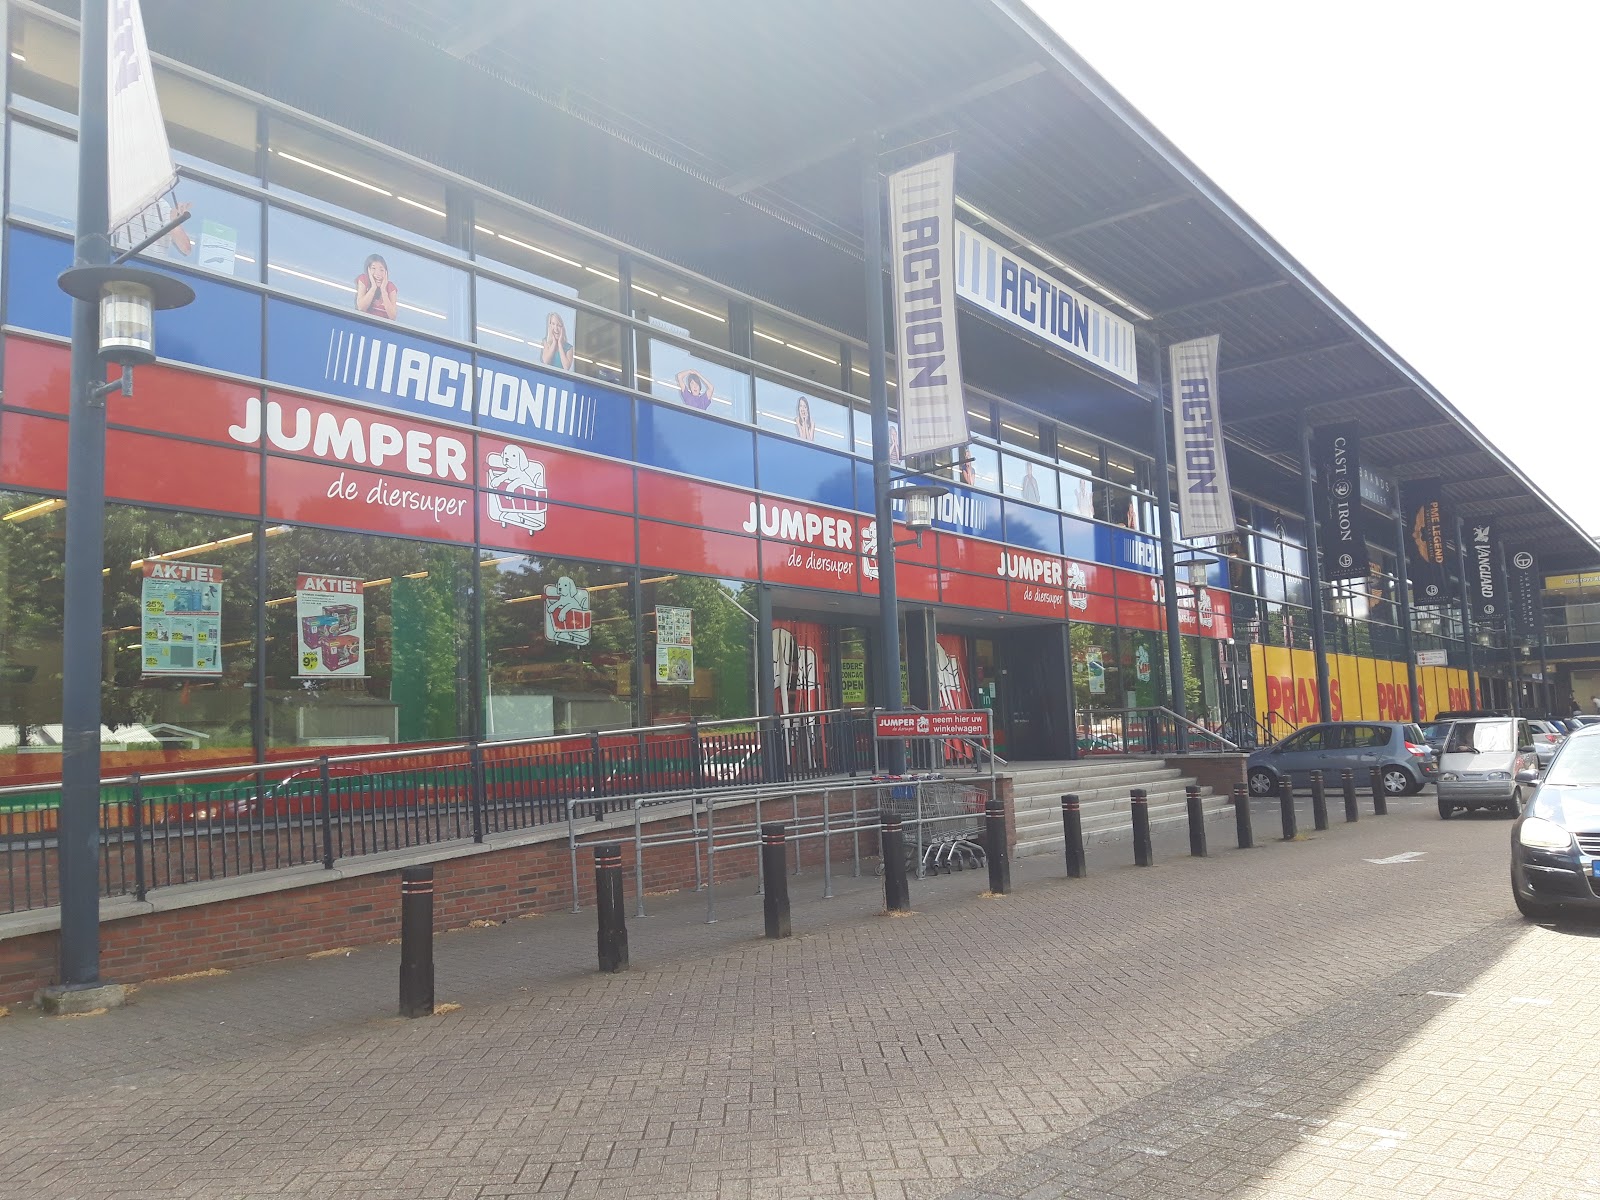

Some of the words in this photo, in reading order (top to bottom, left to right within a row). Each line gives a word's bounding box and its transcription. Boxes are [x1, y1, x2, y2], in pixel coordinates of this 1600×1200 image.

[902, 216, 947, 388] ACTION
[1000, 256, 1088, 353] ACTION
[396, 347, 546, 430] ACTION
[228, 397, 467, 481] JUMPER
[1181, 378, 1218, 493] ACTION
[1335, 437, 1347, 475] CAST
[327, 472, 358, 500] de
[366, 478, 467, 522] diersuper
[1431, 501, 1440, 523] PME
[743, 501, 853, 549] JUMPER
[1338, 502, 1352, 541] IRON
[1432, 525, 1444, 563] LEGEND
[151, 564, 214, 582] AKTIE!
[787, 550, 803, 567] de
[805, 551, 854, 579] diersuper
[997, 552, 1063, 586] JUMPER
[1474, 545, 1494, 598] VANGUARD
[304, 577, 357, 593] AKTIE!
[1023, 590, 1033, 601] de
[842, 680, 863, 691] OPEN
[1267, 675, 1341, 724] PRAXS
[1377, 682, 1426, 720] PRAXS
[879, 718, 914, 727] JUMPER
[934, 725, 982, 734] winkelwagen
[954, 715, 969, 723] hier
